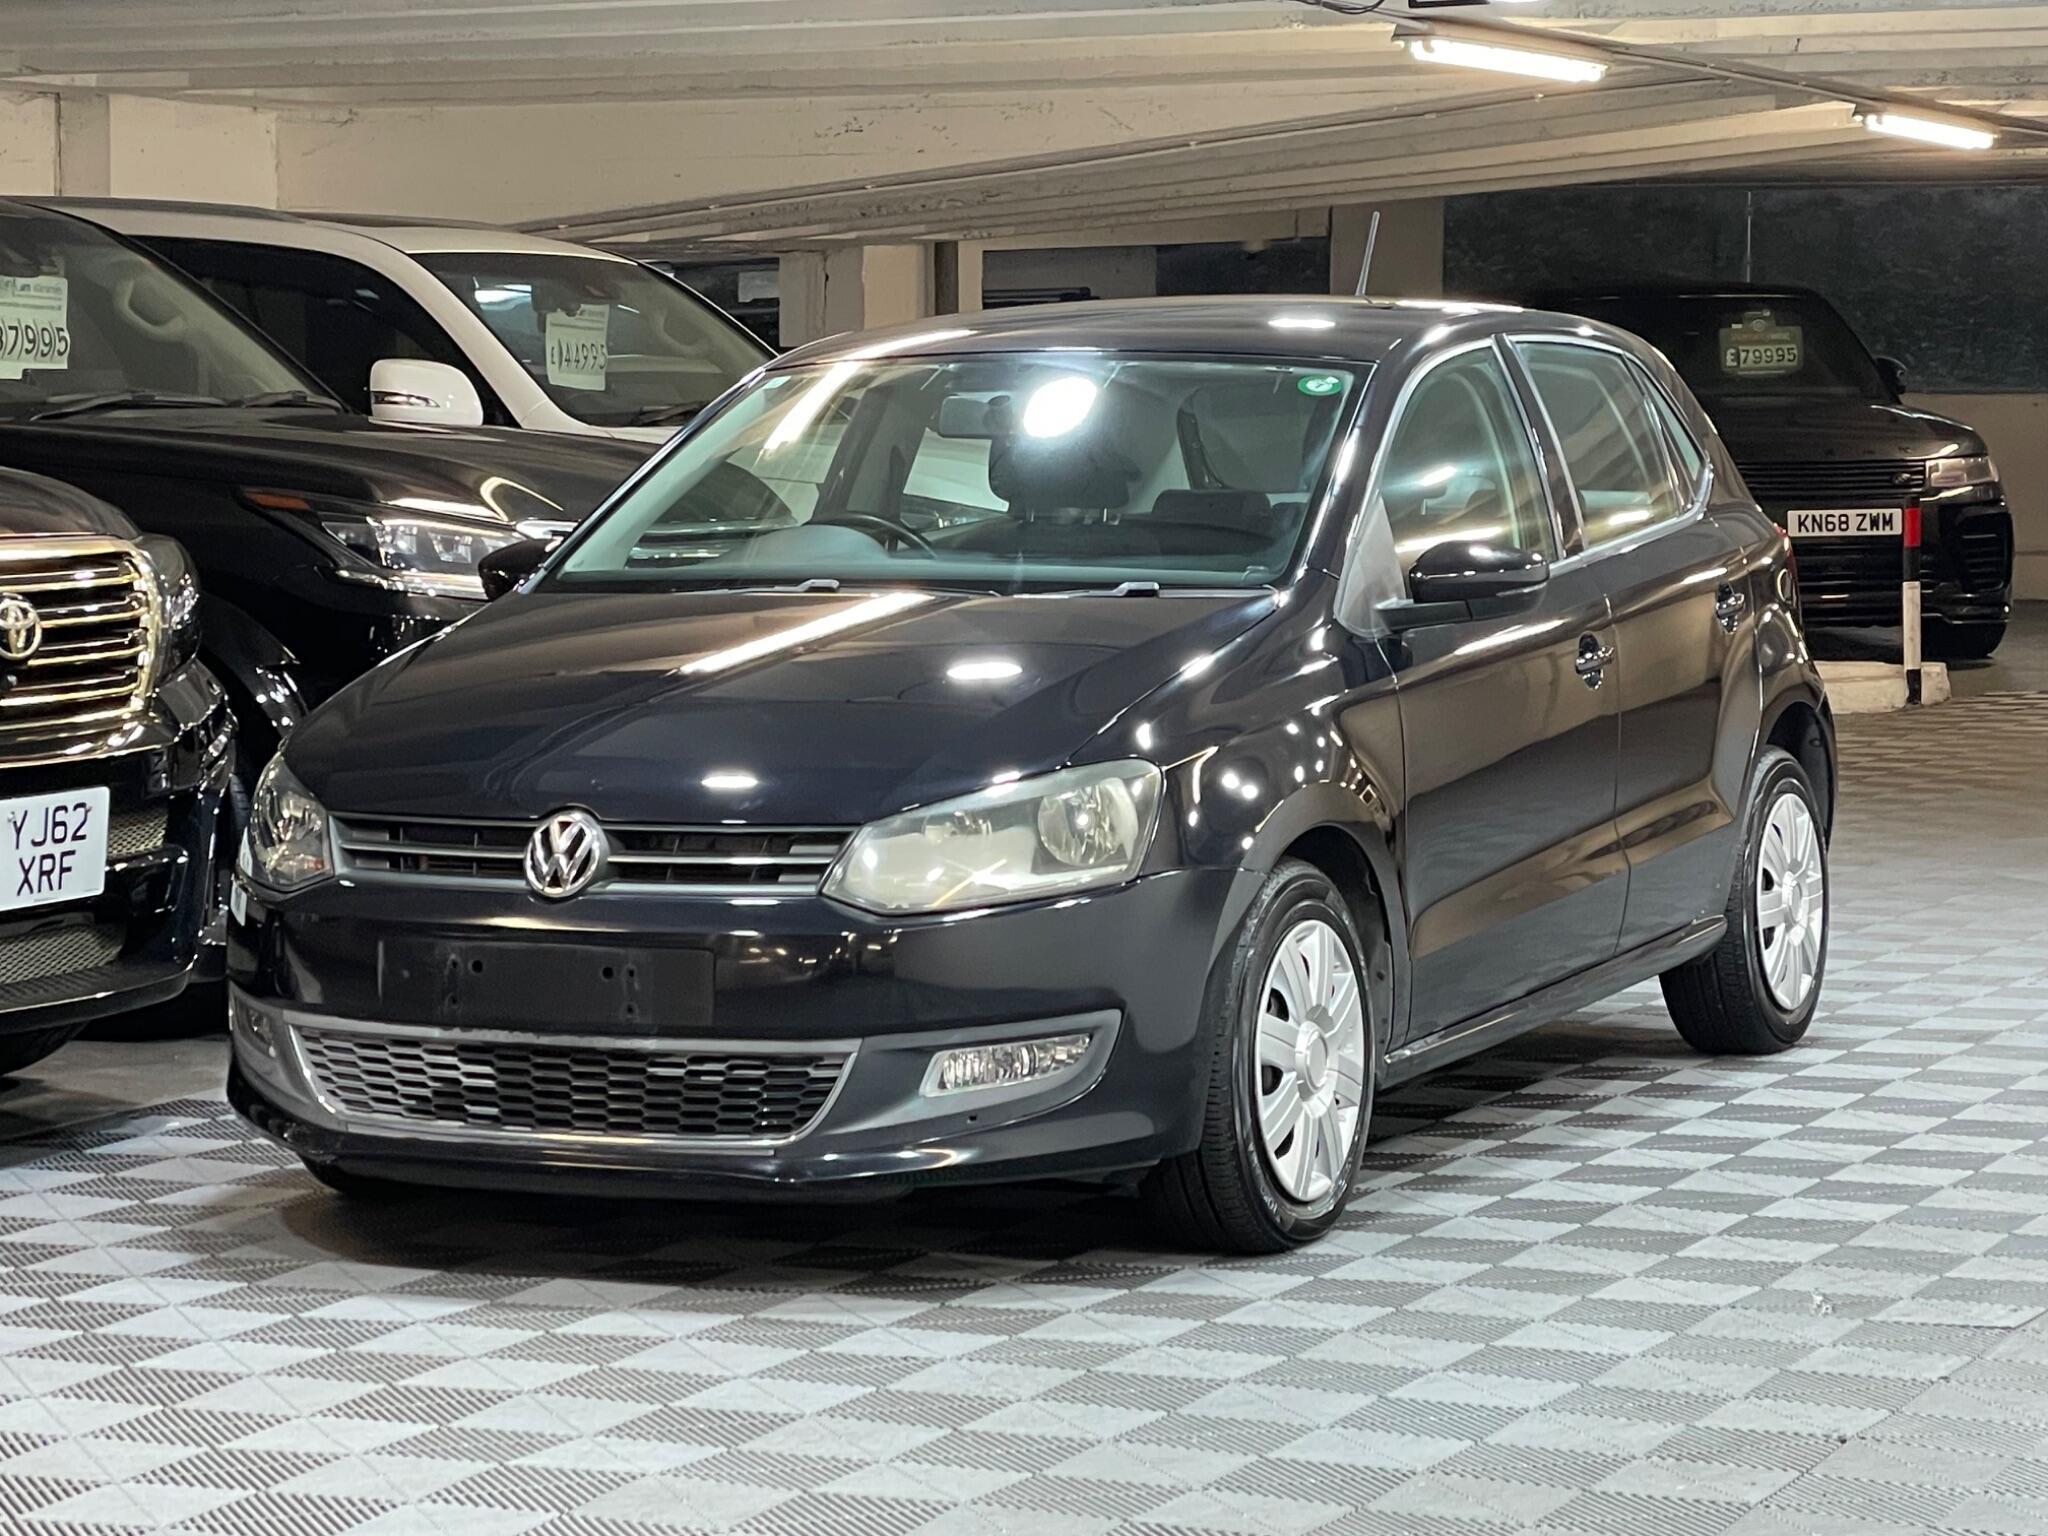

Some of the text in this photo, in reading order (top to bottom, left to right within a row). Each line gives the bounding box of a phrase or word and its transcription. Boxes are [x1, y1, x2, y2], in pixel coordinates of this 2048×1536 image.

[0, 324, 69, 358] 7995
[1796, 512, 1894, 534] KN68 ZWM
[11, 801, 88, 850] YJ62
[16, 849, 77, 896] XRF
